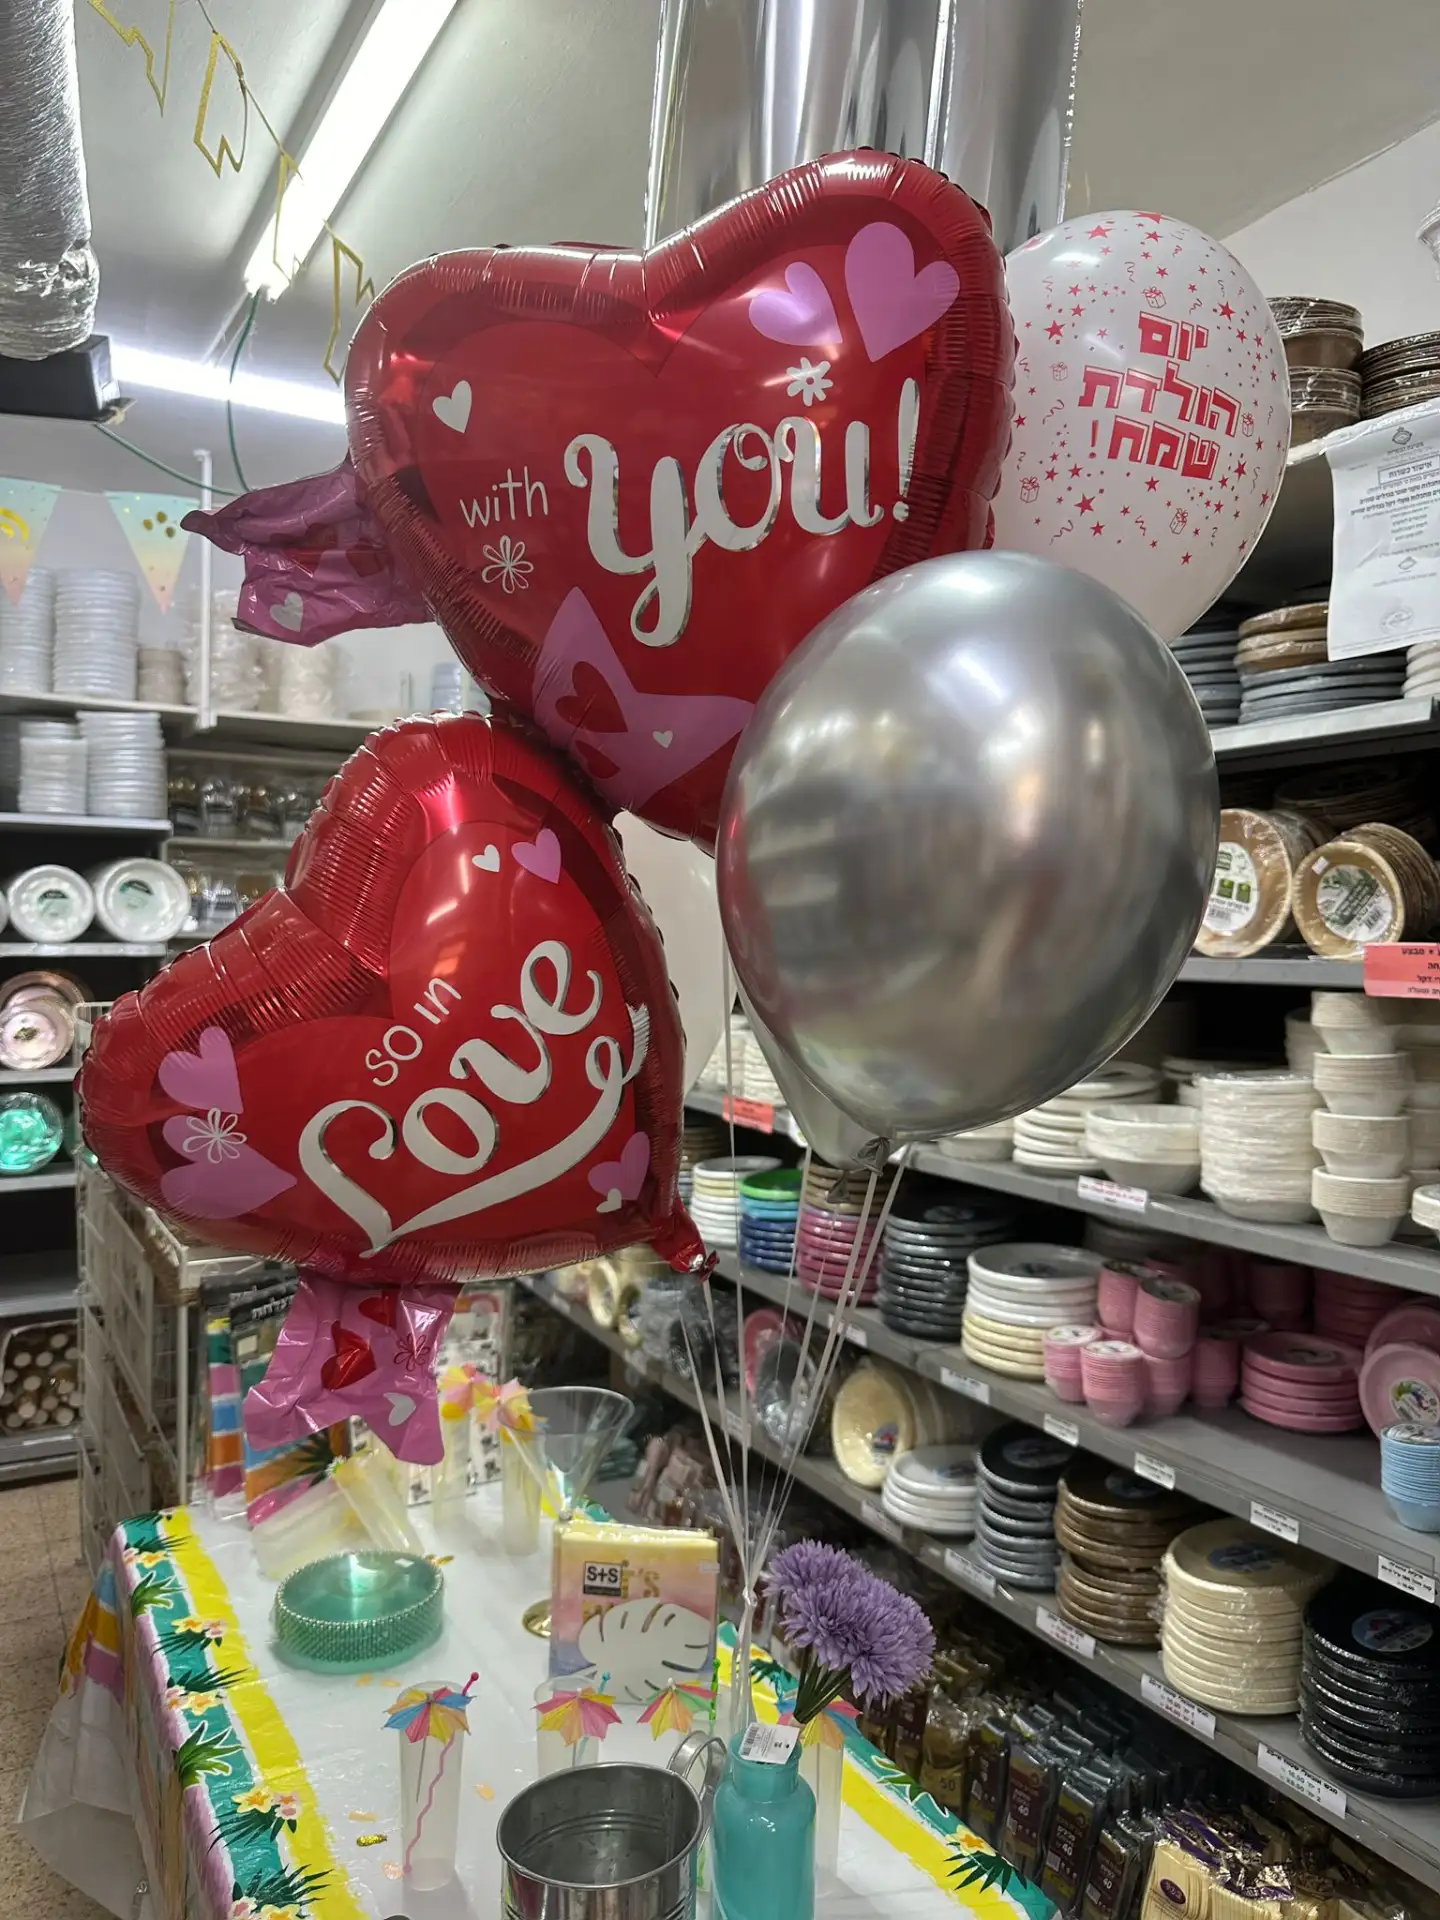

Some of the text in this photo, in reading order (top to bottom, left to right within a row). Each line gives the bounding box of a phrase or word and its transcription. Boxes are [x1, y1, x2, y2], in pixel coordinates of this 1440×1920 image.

[1138, 311, 1209, 361] יום
[1078, 360, 1241, 437] הולדת
[1089, 415, 1220, 480] שמח!
[459, 465, 548, 528] with
[299, 940, 649, 1258] Love
